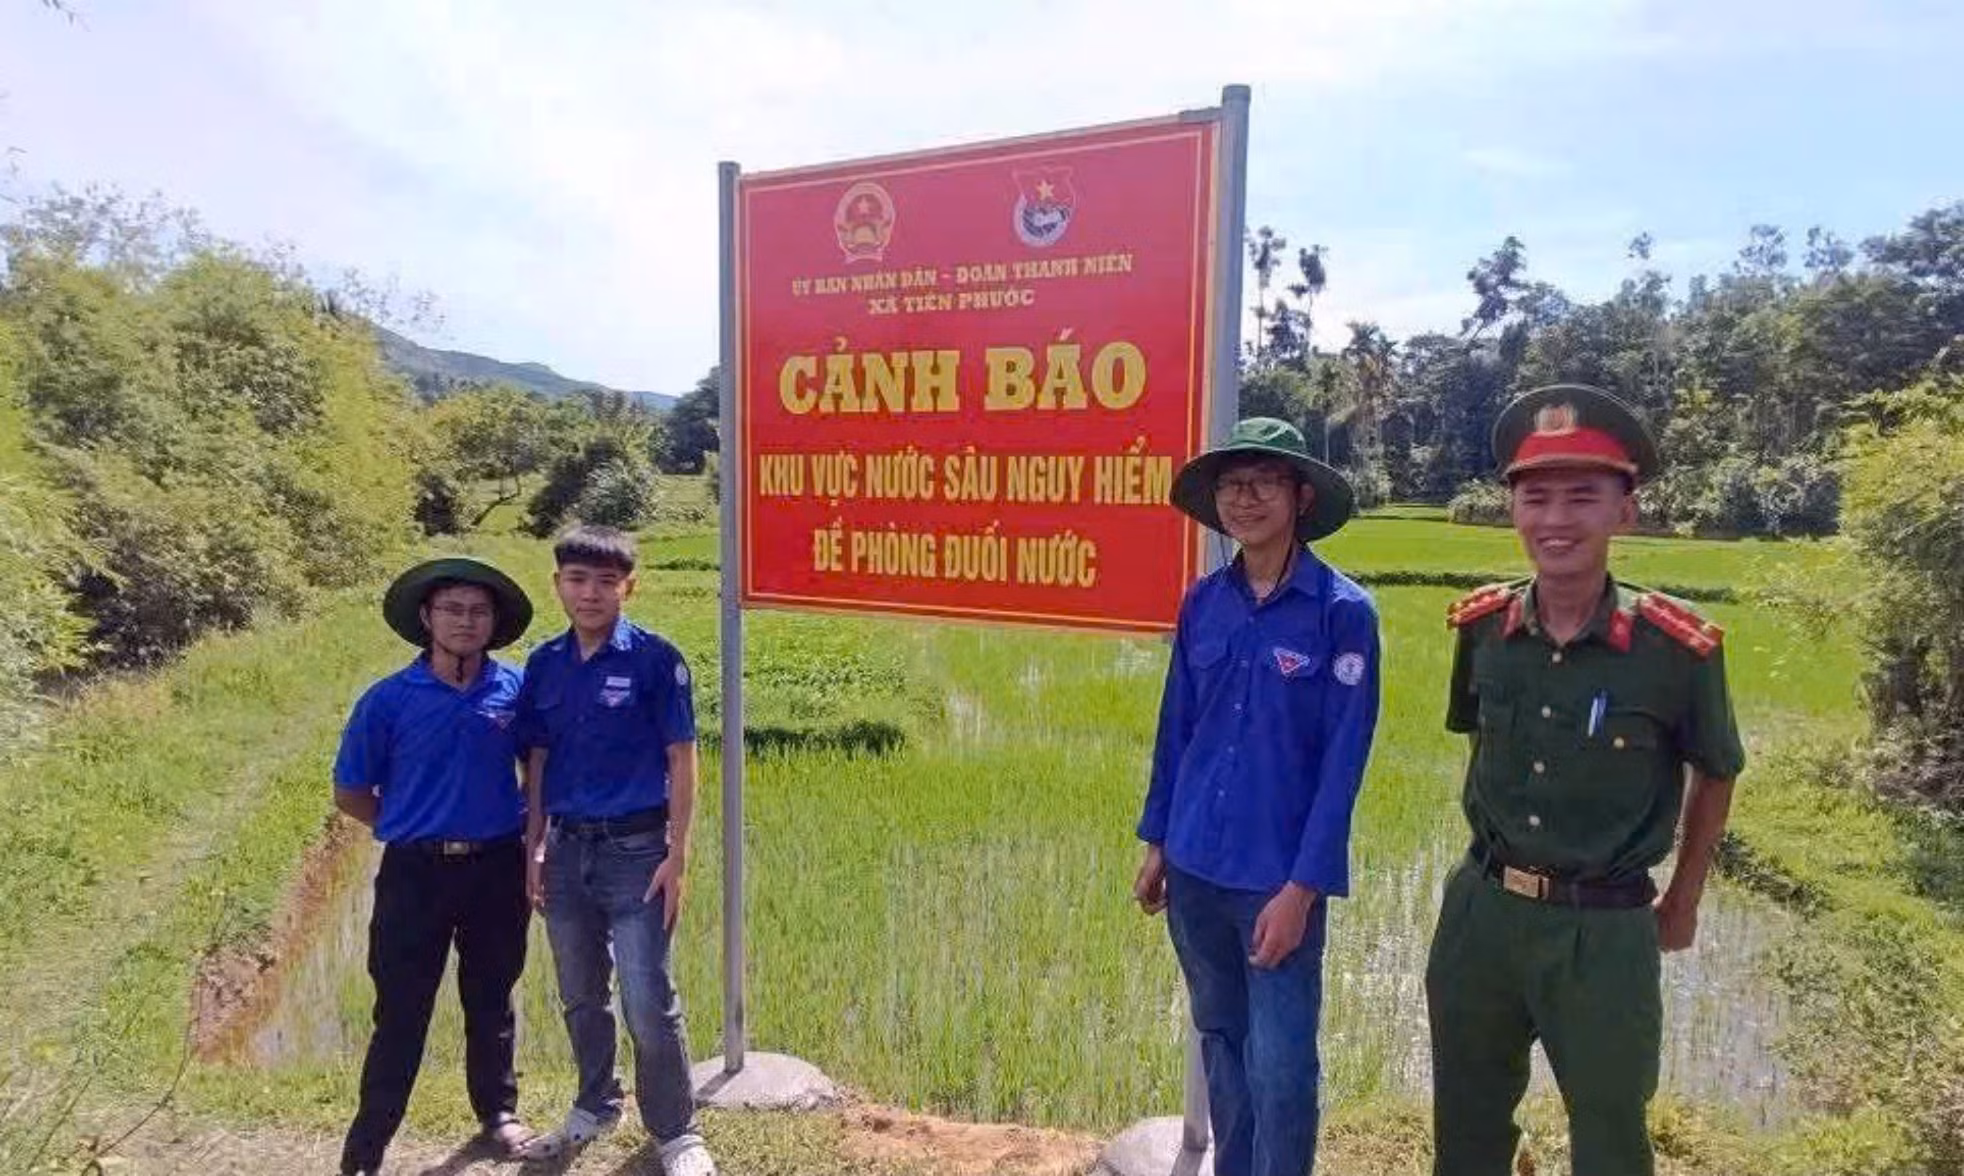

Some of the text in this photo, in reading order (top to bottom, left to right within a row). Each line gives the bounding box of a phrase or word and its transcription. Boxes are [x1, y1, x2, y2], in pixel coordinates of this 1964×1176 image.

[814, 276, 847, 295] BAN
[1012, 256, 1078, 280] THANH
[779, 327, 1146, 415] CẢNH BÁO
[760, 436, 1173, 506] KHU VỰC NƯỚC SÂU NGUY HIỂM
[851, 520, 937, 578] PHÒNG
[944, 519, 1007, 582] ĐUỐI
[1017, 529, 1097, 588] NƯỚC
